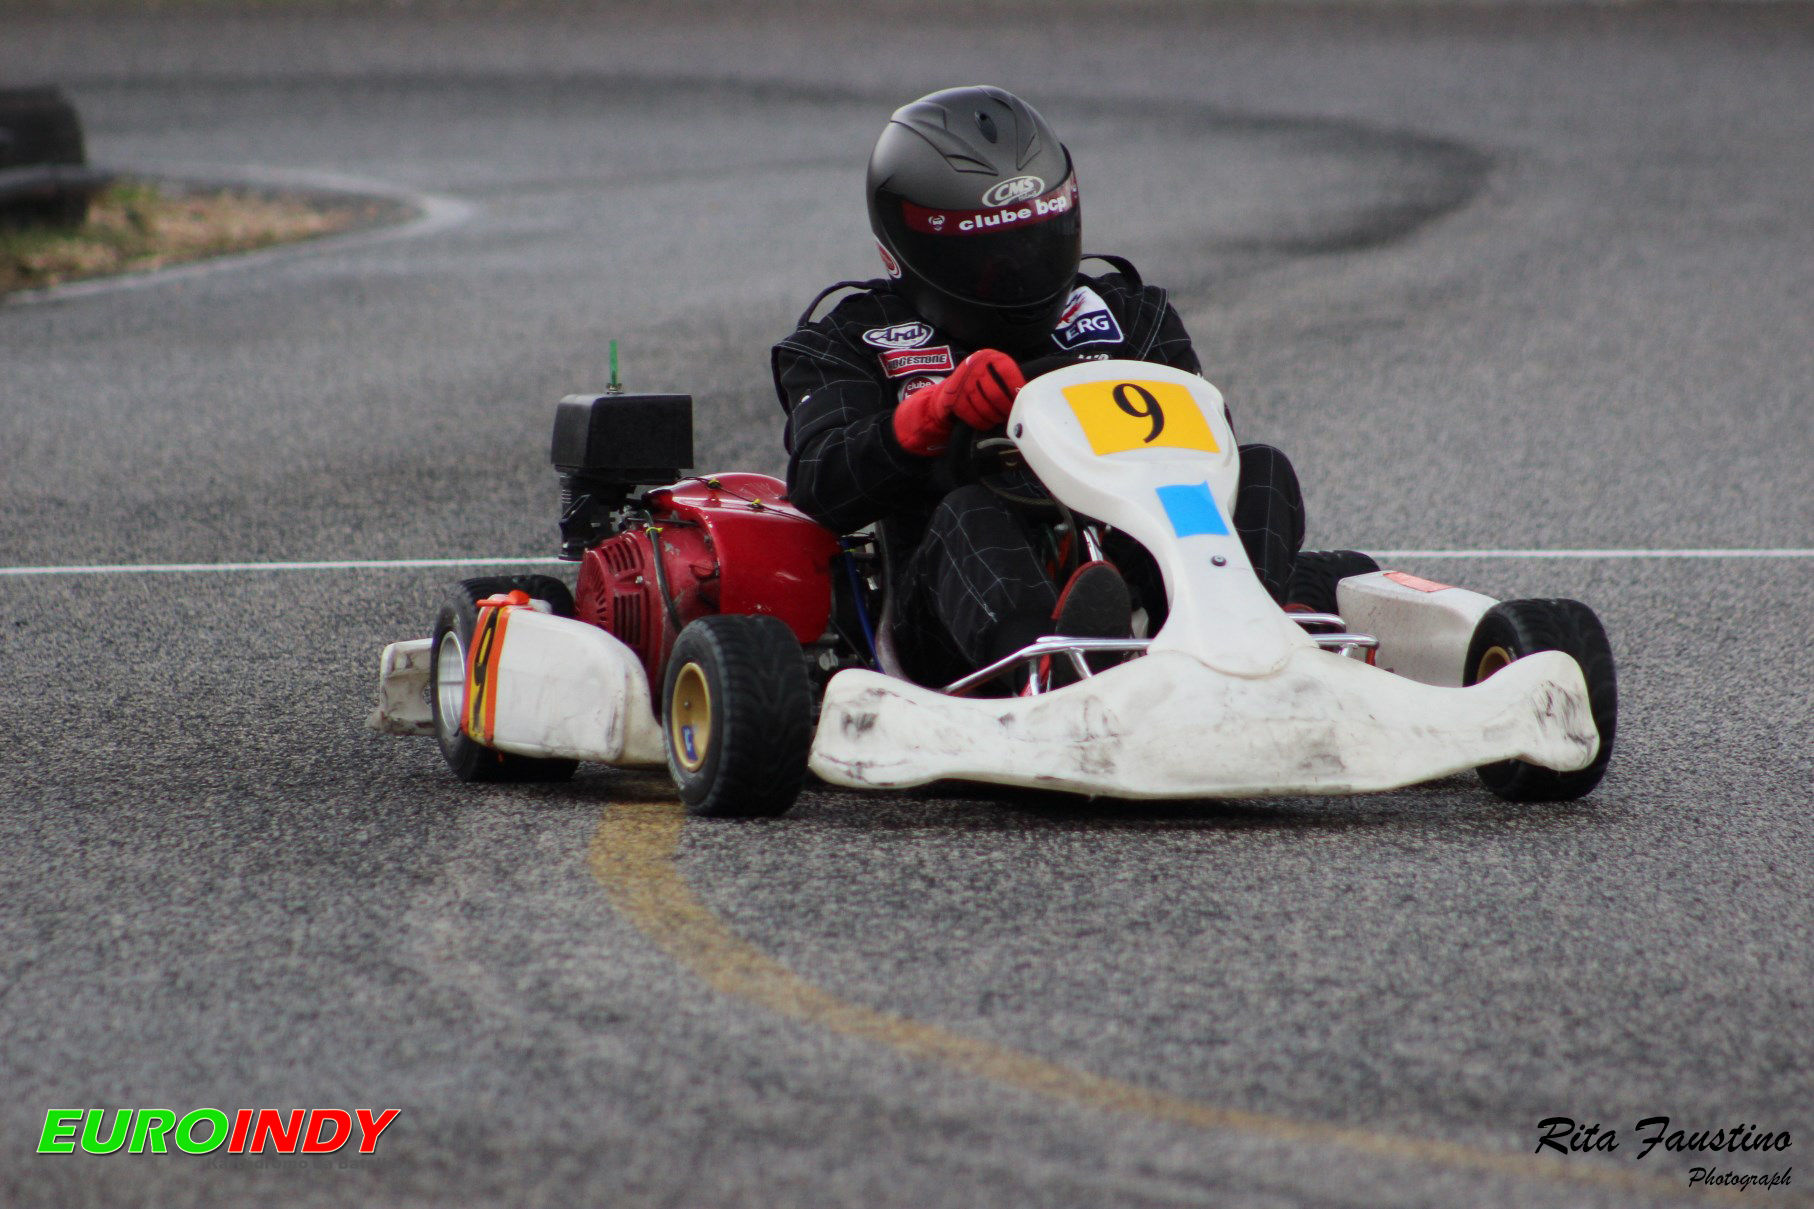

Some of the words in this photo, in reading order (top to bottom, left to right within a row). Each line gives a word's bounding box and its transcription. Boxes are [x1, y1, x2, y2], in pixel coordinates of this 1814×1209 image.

[994, 178, 1035, 201] CMS
[959, 208, 1032, 231] clube
[1035, 195, 1067, 215] bcp
[907, 380, 932, 391] clube
[1112, 383, 1165, 443] 9
